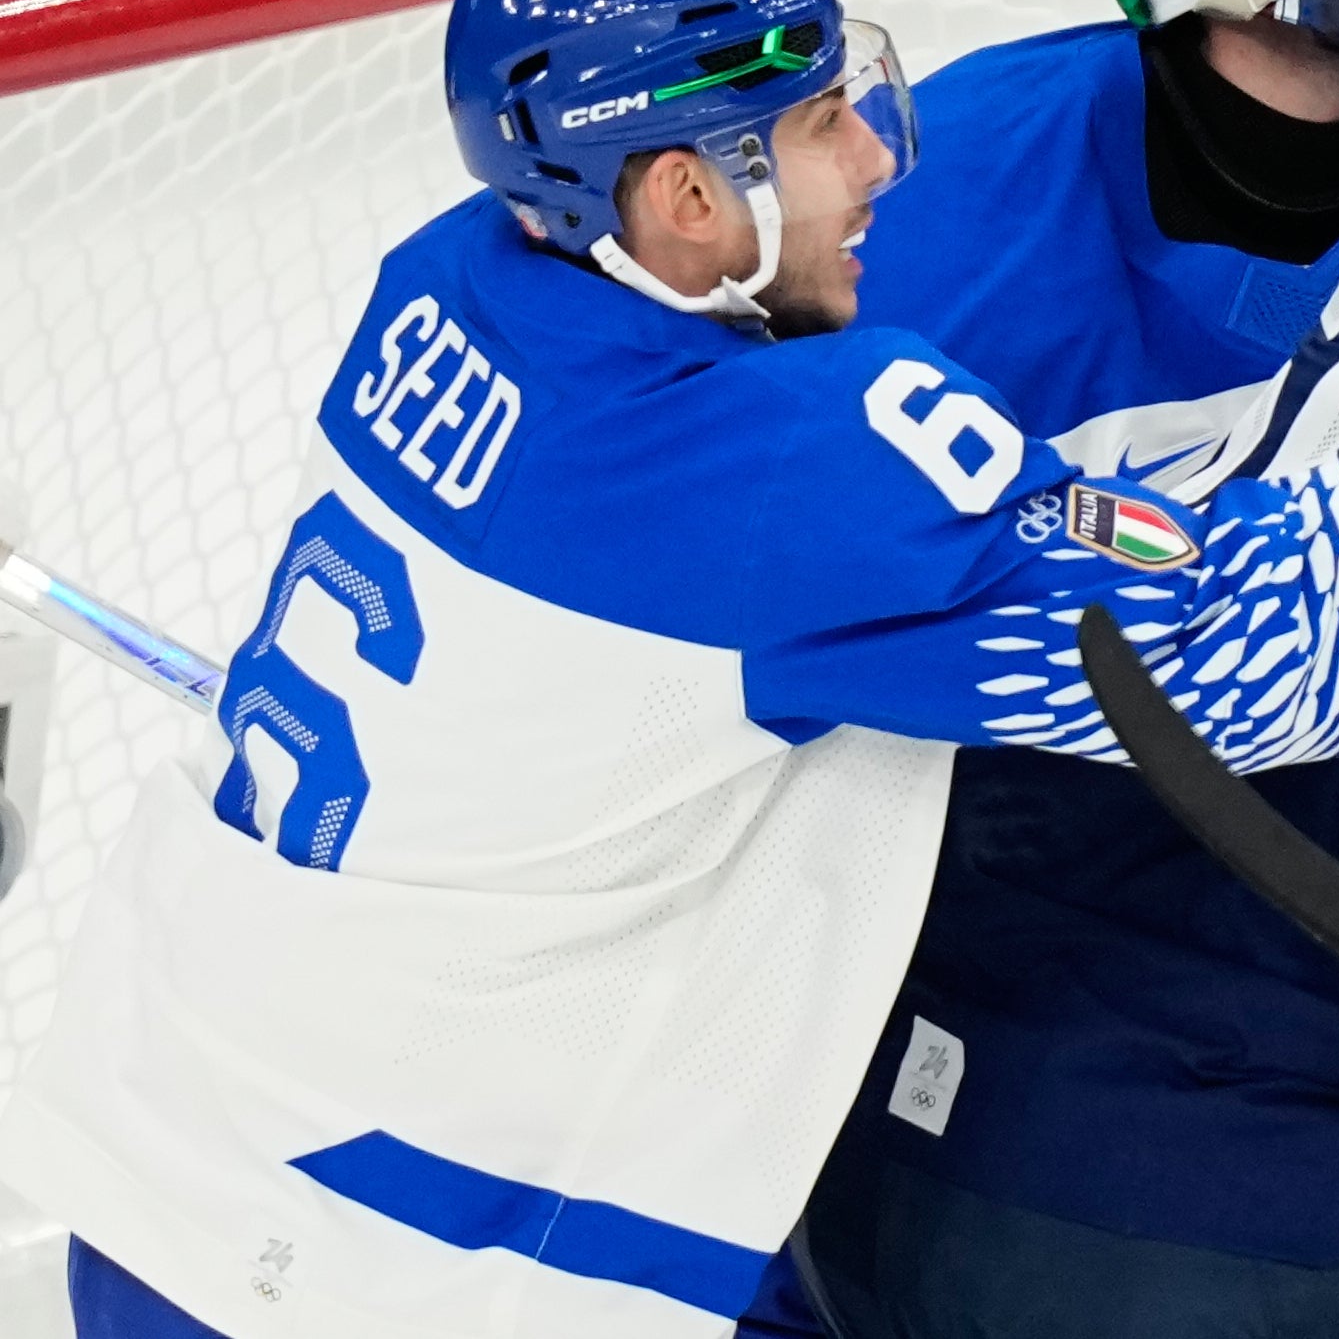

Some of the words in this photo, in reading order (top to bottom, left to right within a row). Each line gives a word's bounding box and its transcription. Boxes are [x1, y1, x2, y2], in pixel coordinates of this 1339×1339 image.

[561, 91, 649, 129] CCM
[353, 294, 522, 510] SEED
[863, 359, 1024, 515] 6
